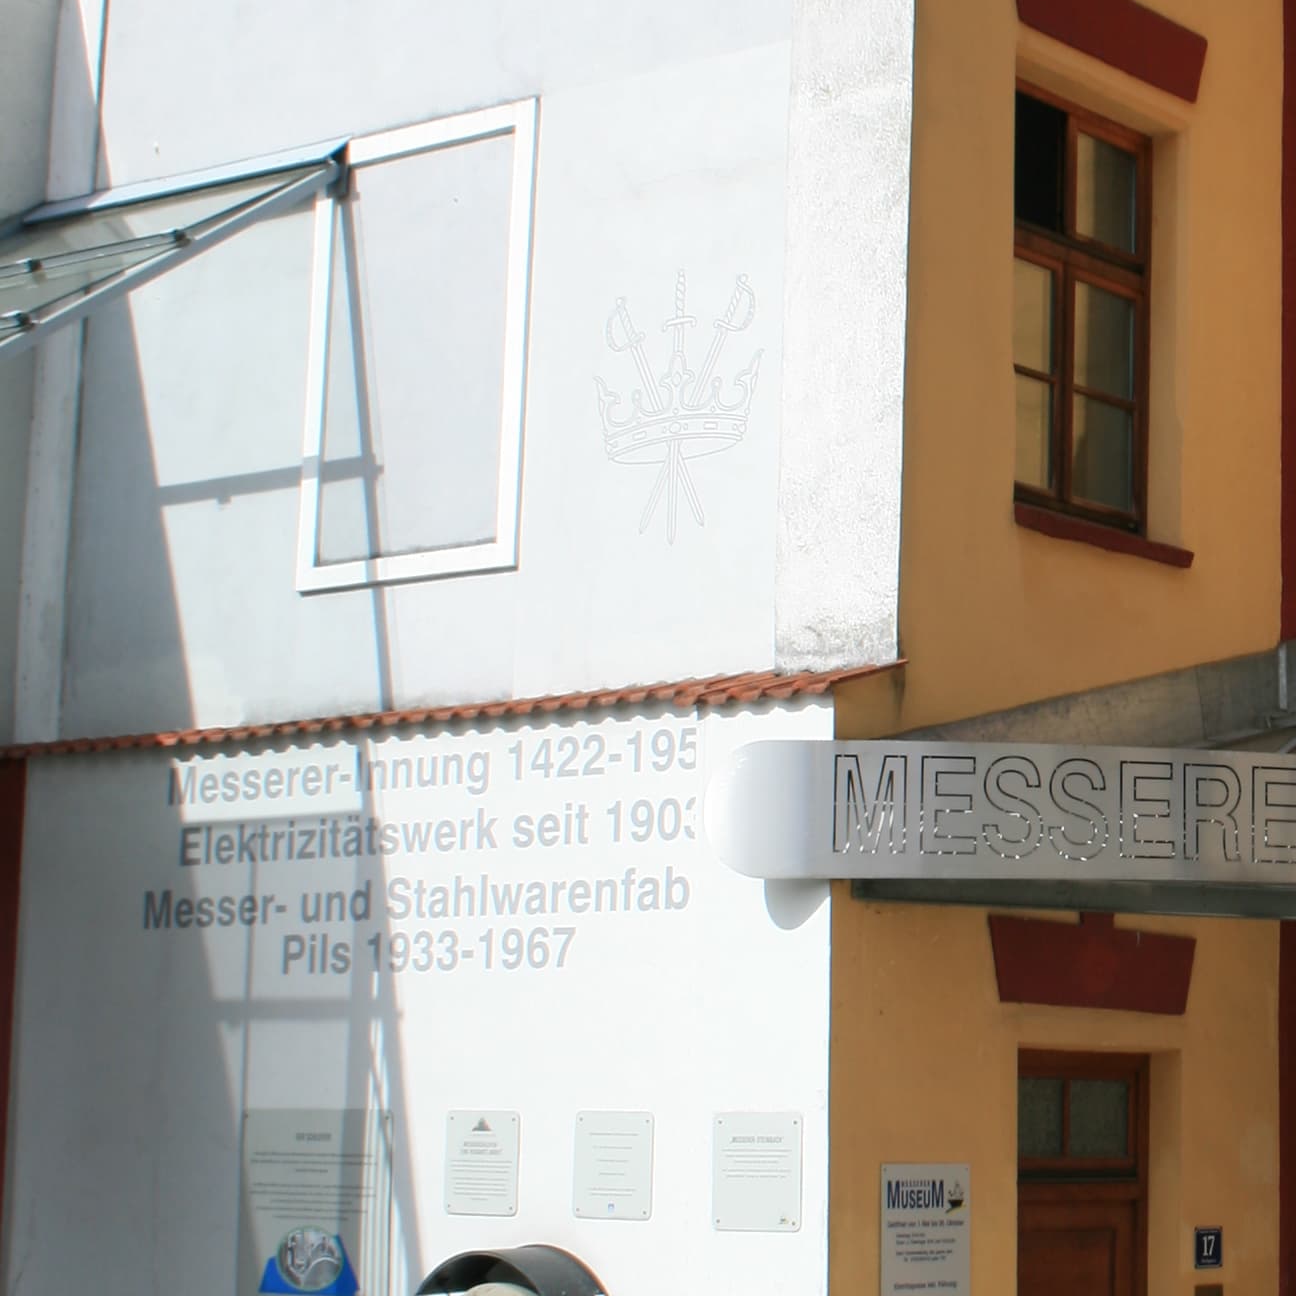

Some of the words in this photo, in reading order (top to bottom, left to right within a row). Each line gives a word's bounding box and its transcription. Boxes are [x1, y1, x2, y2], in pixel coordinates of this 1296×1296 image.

[168, 750, 491, 806] Messerer-Innung
[180, 808, 498, 867] Elektrizitätswerk
[512, 802, 589, 848] seit
[143, 889, 287, 930] Messer-
[301, 879, 371, 923] und
[386, 866, 690, 921] Stahlwarenfab
[282, 933, 351, 975] Pils
[367, 926, 577, 973] 1933-1967
[1203, 1235, 1216, 1256] 17
